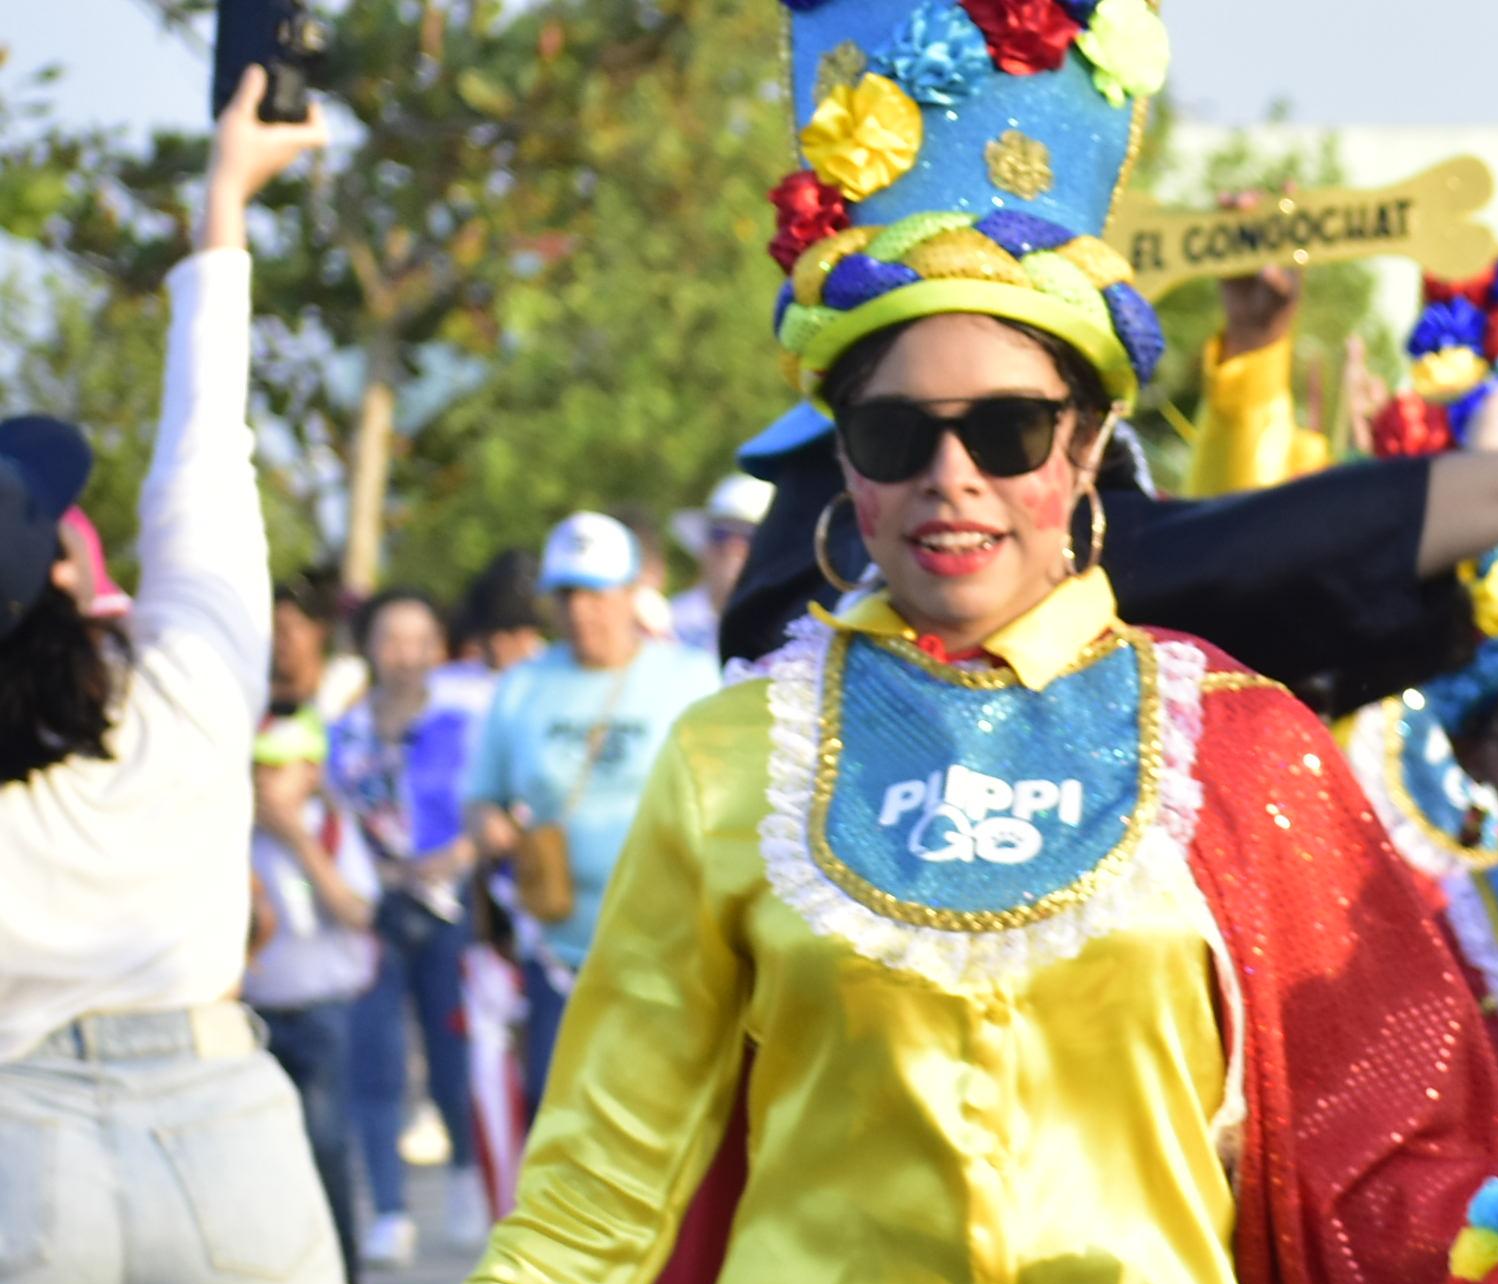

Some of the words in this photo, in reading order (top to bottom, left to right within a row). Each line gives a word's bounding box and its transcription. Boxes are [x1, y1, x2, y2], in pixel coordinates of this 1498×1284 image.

[1132, 230, 1164, 270] EL
[879, 764, 1084, 826] PUPPI
[908, 804, 1042, 865] GO
